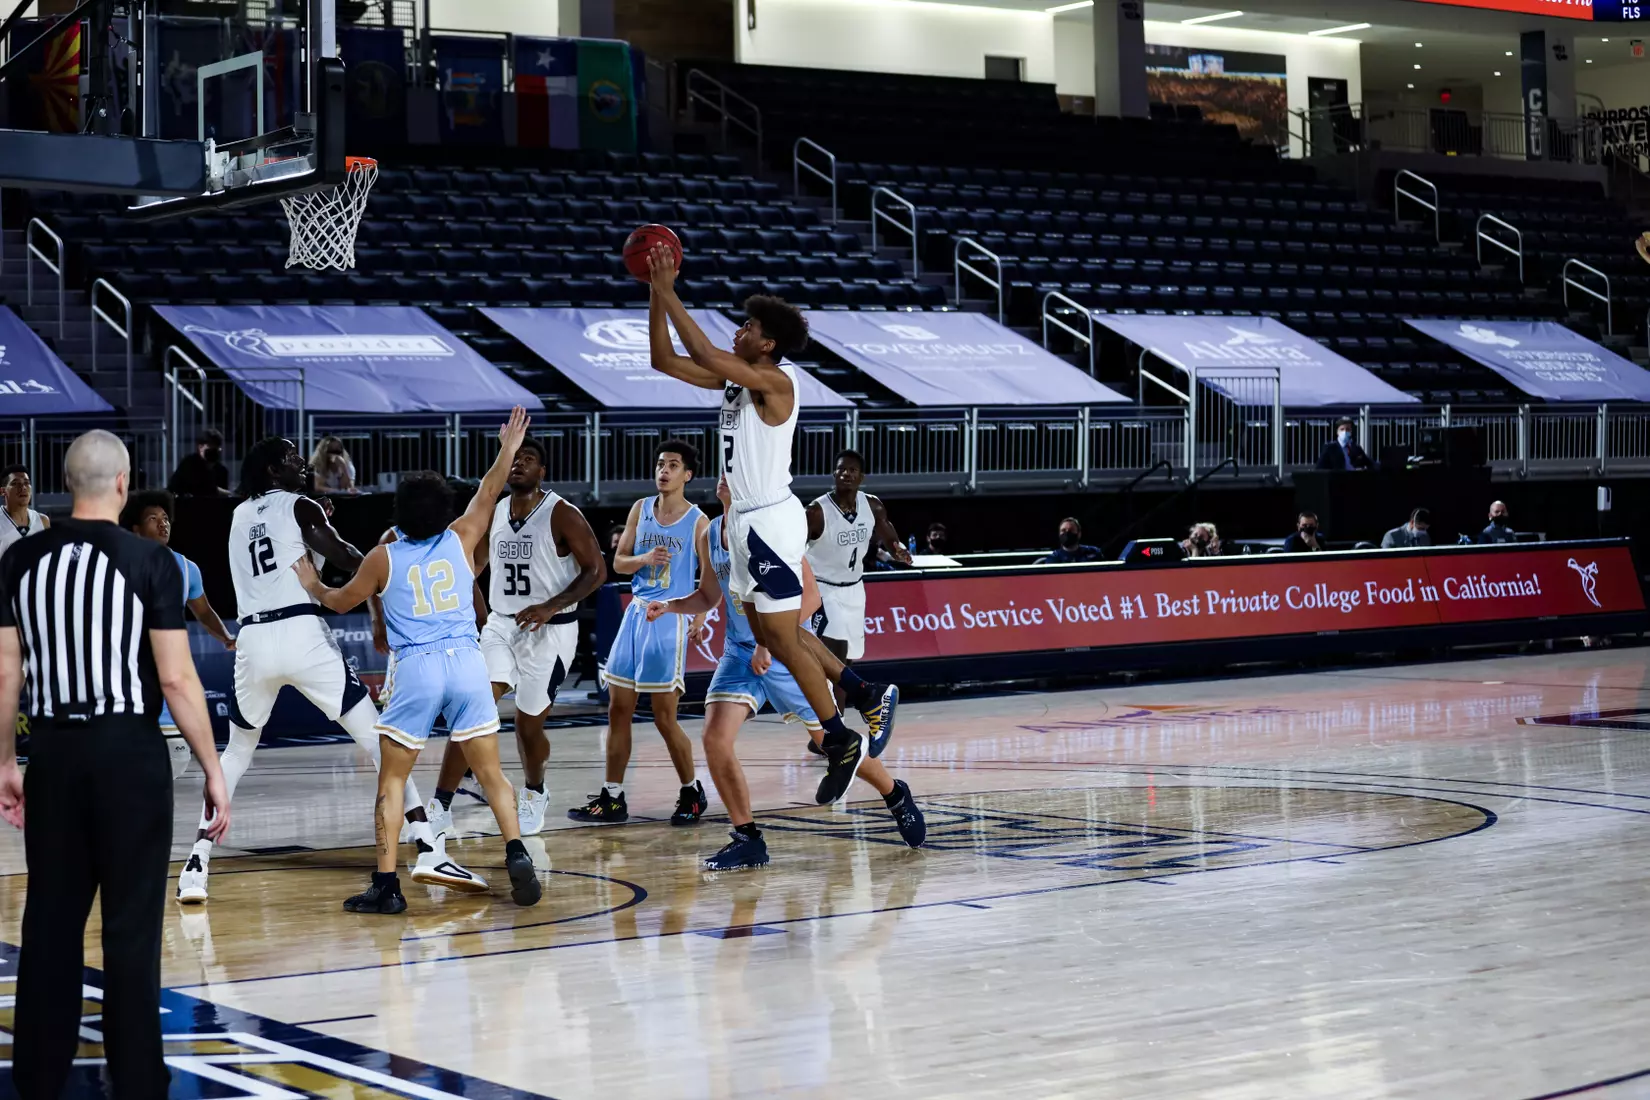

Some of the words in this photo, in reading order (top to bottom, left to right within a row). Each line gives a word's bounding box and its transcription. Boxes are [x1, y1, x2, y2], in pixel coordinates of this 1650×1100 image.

[1622, 6, 1641, 19] FLS
[1183, 340, 1312, 361] Altura
[837, 528, 868, 546] CBU
[248, 536, 277, 577] 12
[498, 540, 533, 560] CBU
[848, 547, 858, 572] 4
[407, 558, 460, 617] 12
[503, 562, 531, 596] 35
[890, 603, 956, 633] Food
[960, 600, 1044, 629] Service
[1045, 595, 1114, 624] Voted
[1119, 594, 1148, 620] #1
[1154, 593, 1200, 618] Best
[1204, 589, 1280, 615] Private
[1285, 583, 1361, 613] College
[1364, 578, 1416, 605] Food
[1417, 578, 1440, 602] in
[1443, 573, 1542, 600] California!
